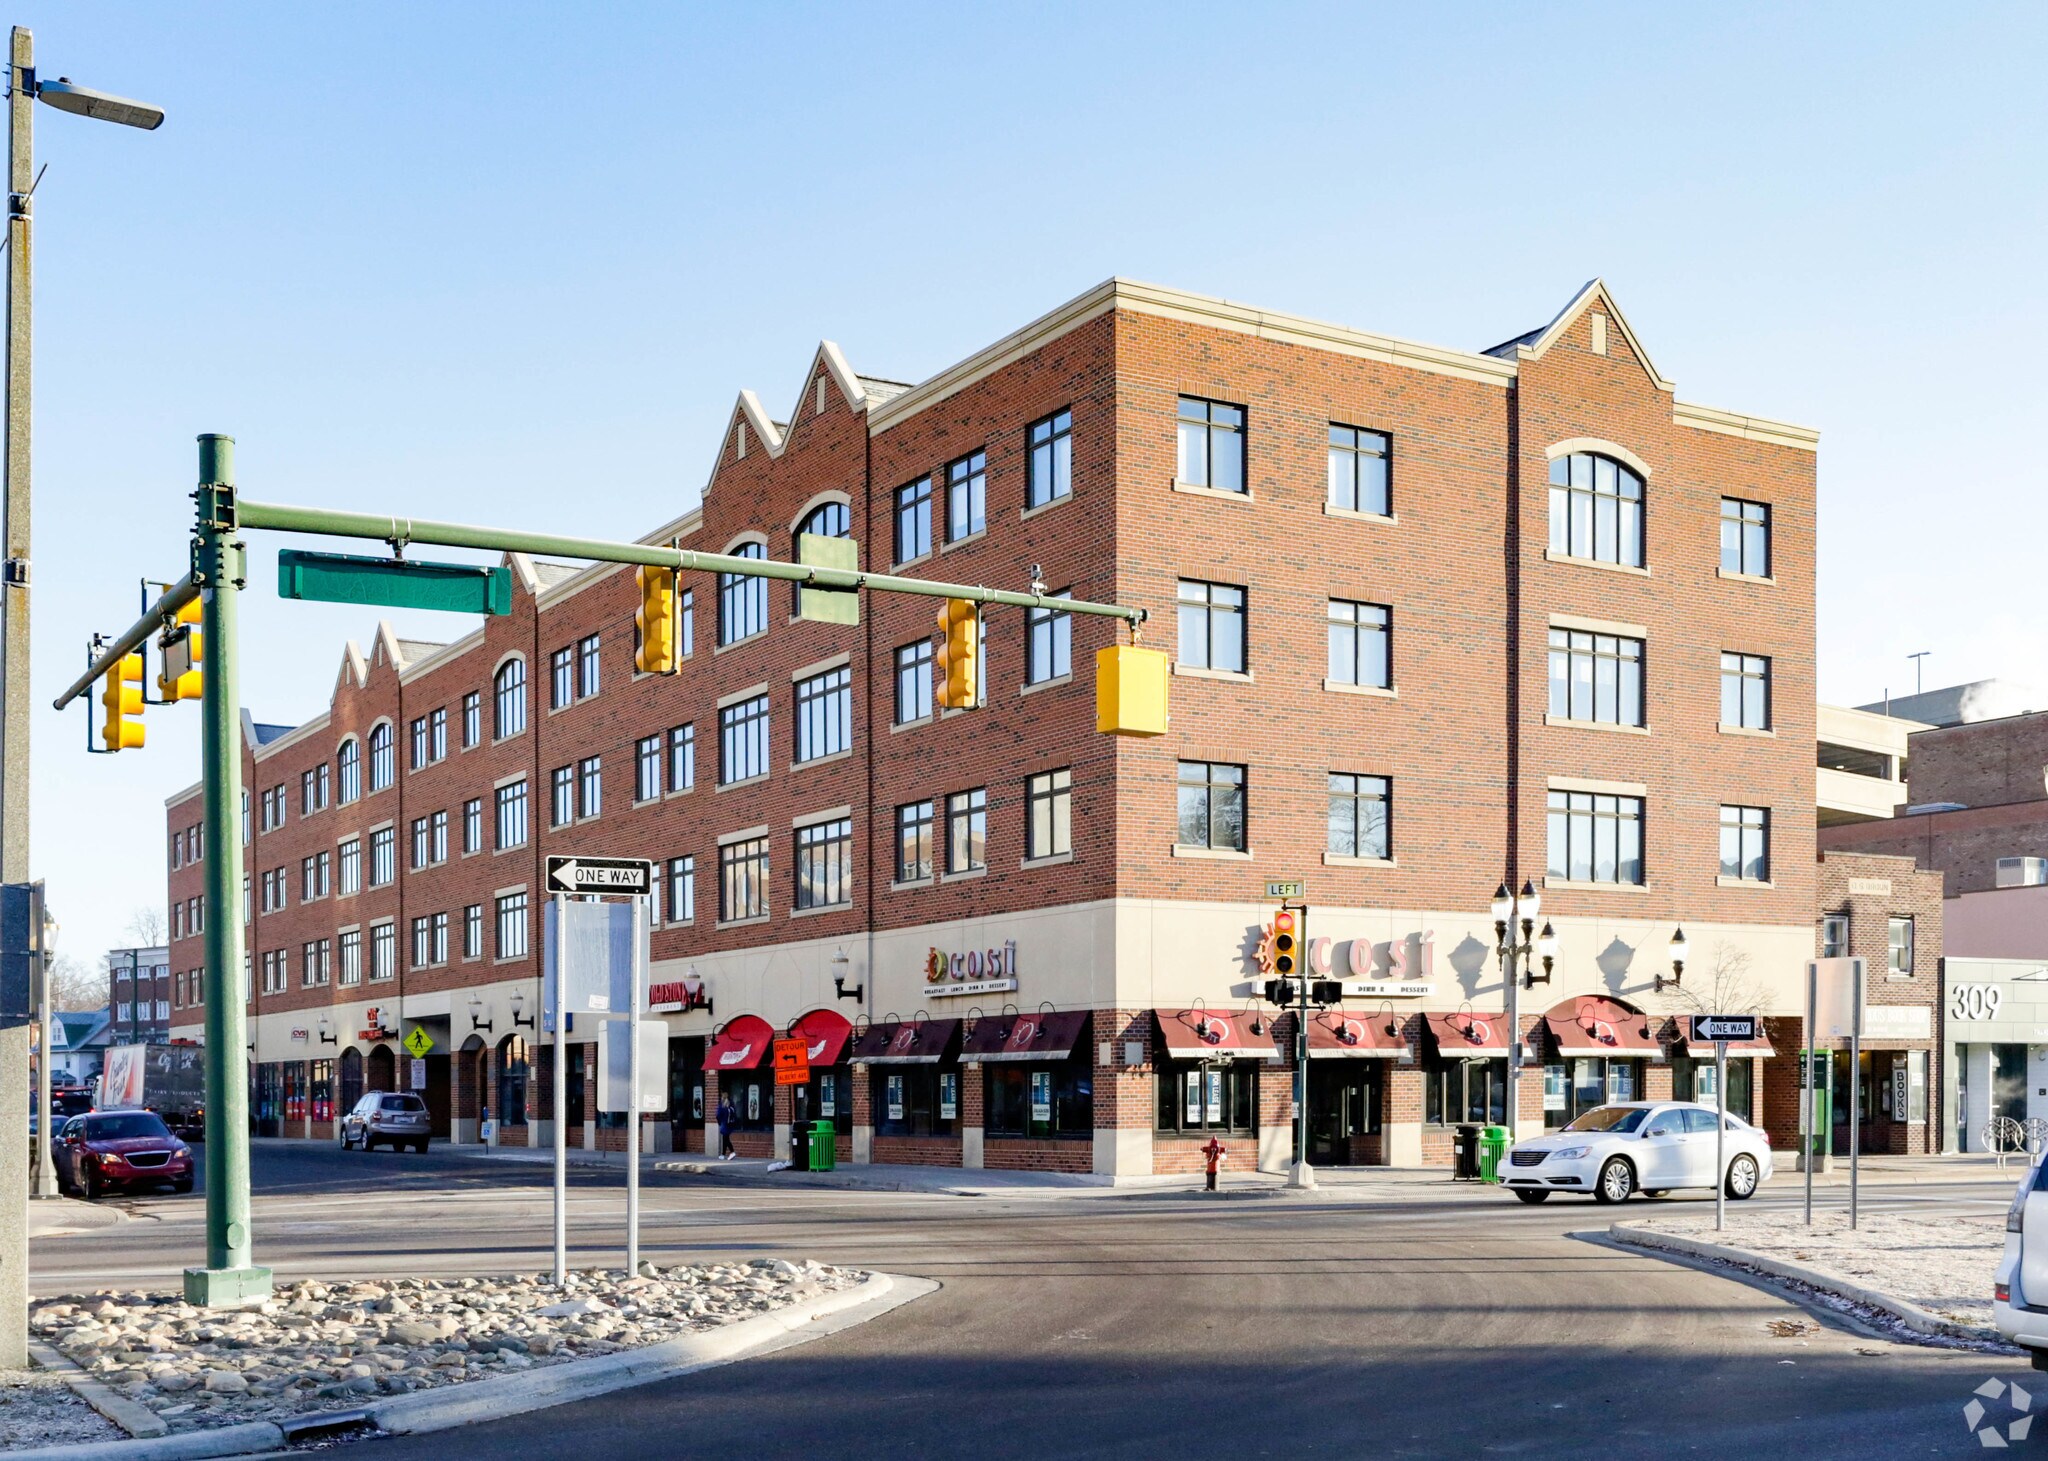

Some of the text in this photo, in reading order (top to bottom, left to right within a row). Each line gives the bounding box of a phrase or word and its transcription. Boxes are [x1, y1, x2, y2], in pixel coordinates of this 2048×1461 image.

[575, 868, 640, 884] ONE WAY
[1270, 884, 1298, 895] LEFT
[650, 984, 664, 1003] OLD
[1952, 984, 2002, 1020] 309
[1709, 1023, 1749, 1034] ONE WAY
[776, 1041, 805, 1052] DETOUR
[1896, 1072, 1905, 1118] BOOKS
